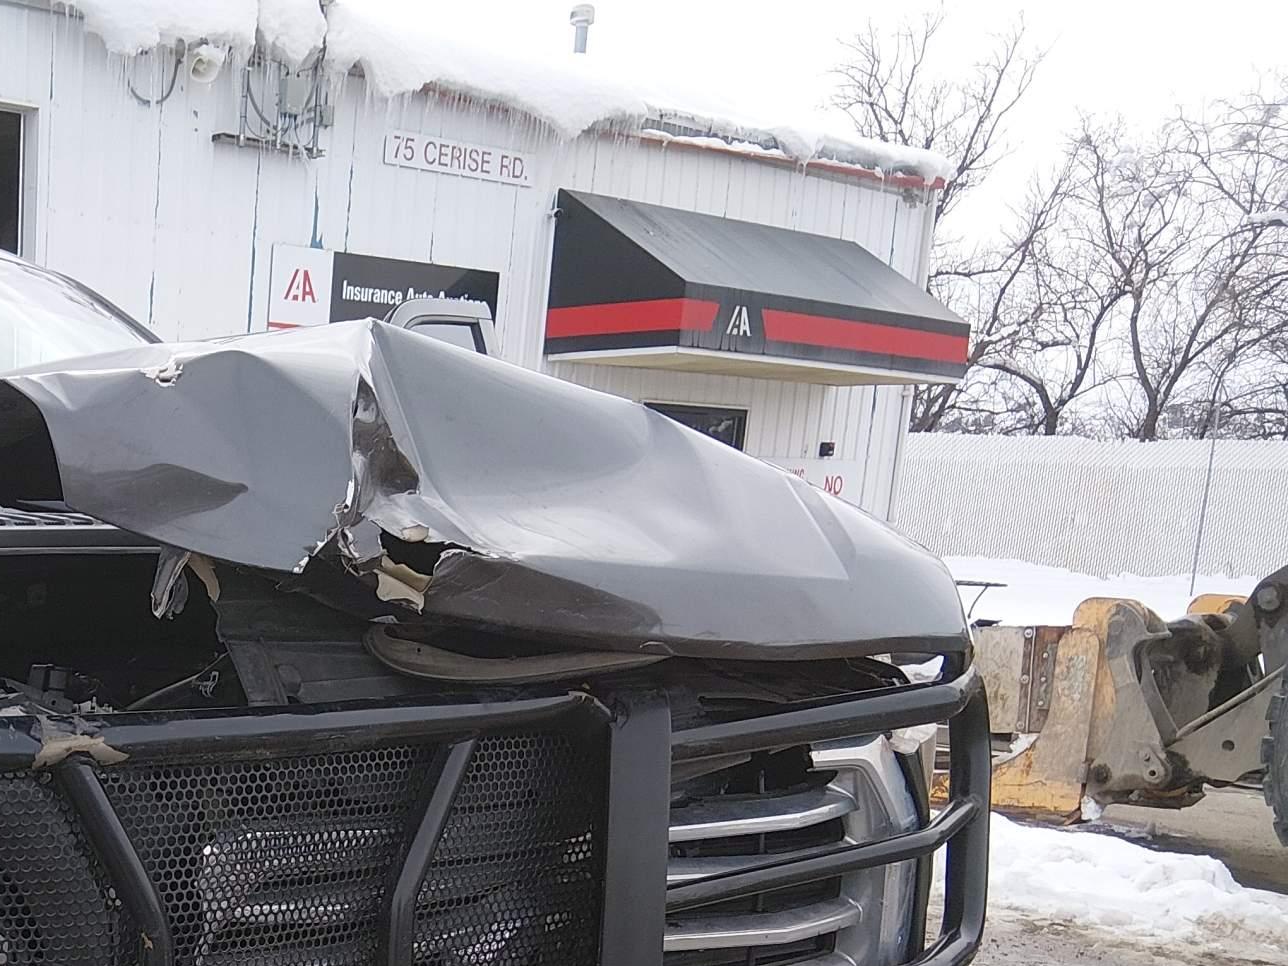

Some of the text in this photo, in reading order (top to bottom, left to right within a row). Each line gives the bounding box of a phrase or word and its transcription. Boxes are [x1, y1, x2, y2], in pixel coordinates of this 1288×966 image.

[394, 135, 528, 181] 75 CERISE RD.
[341, 280, 403, 305] Insurance
[824, 475, 843, 496] NO
